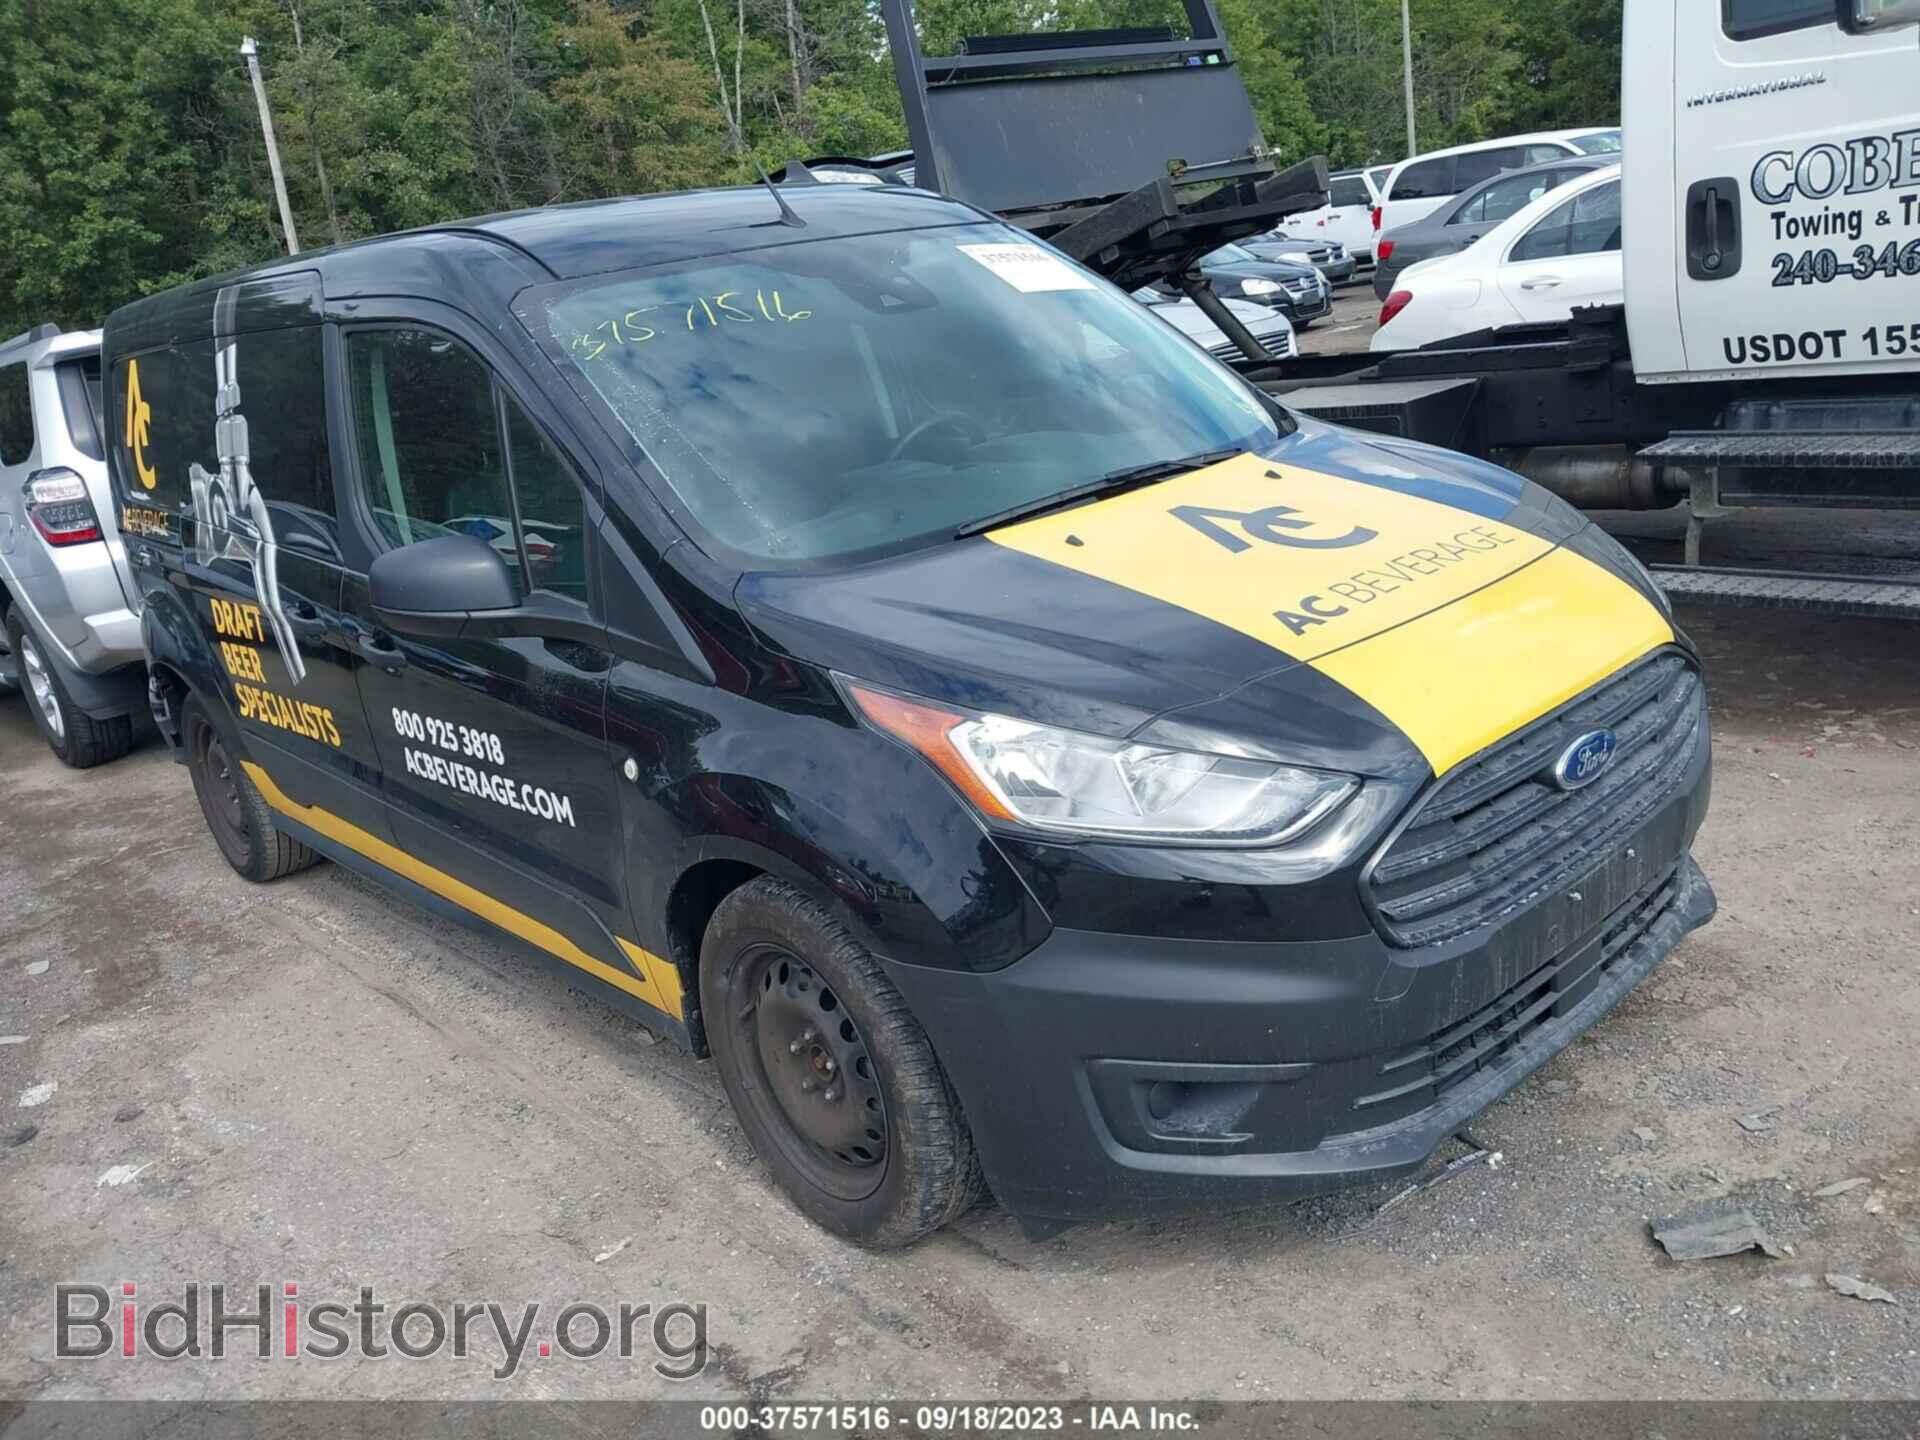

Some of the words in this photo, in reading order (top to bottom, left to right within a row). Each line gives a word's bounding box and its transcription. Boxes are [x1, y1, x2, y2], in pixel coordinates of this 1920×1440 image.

[1687, 71, 1827, 108] INTERNATIONAL
[1771, 206, 1862, 240] Towing
[1875, 210, 1891, 226] &
[1899, 194, 1920, 226] T
[1771, 237, 1920, 287] 240-346
[1723, 329, 1847, 365] USDOT
[1272, 595, 1349, 636] AC
[1328, 526, 1515, 604] BEVERAGE
[210, 598, 264, 642] DRAFT
[220, 641, 267, 683] BEER
[234, 682, 341, 747] SPECIALISTS
[392, 707, 425, 742] 800
[425, 716, 459, 752] 925
[458, 725, 505, 766] 3818
[1576, 734, 1609, 777] Ford
[404, 747, 576, 827] ACBEVERAGE.COM
